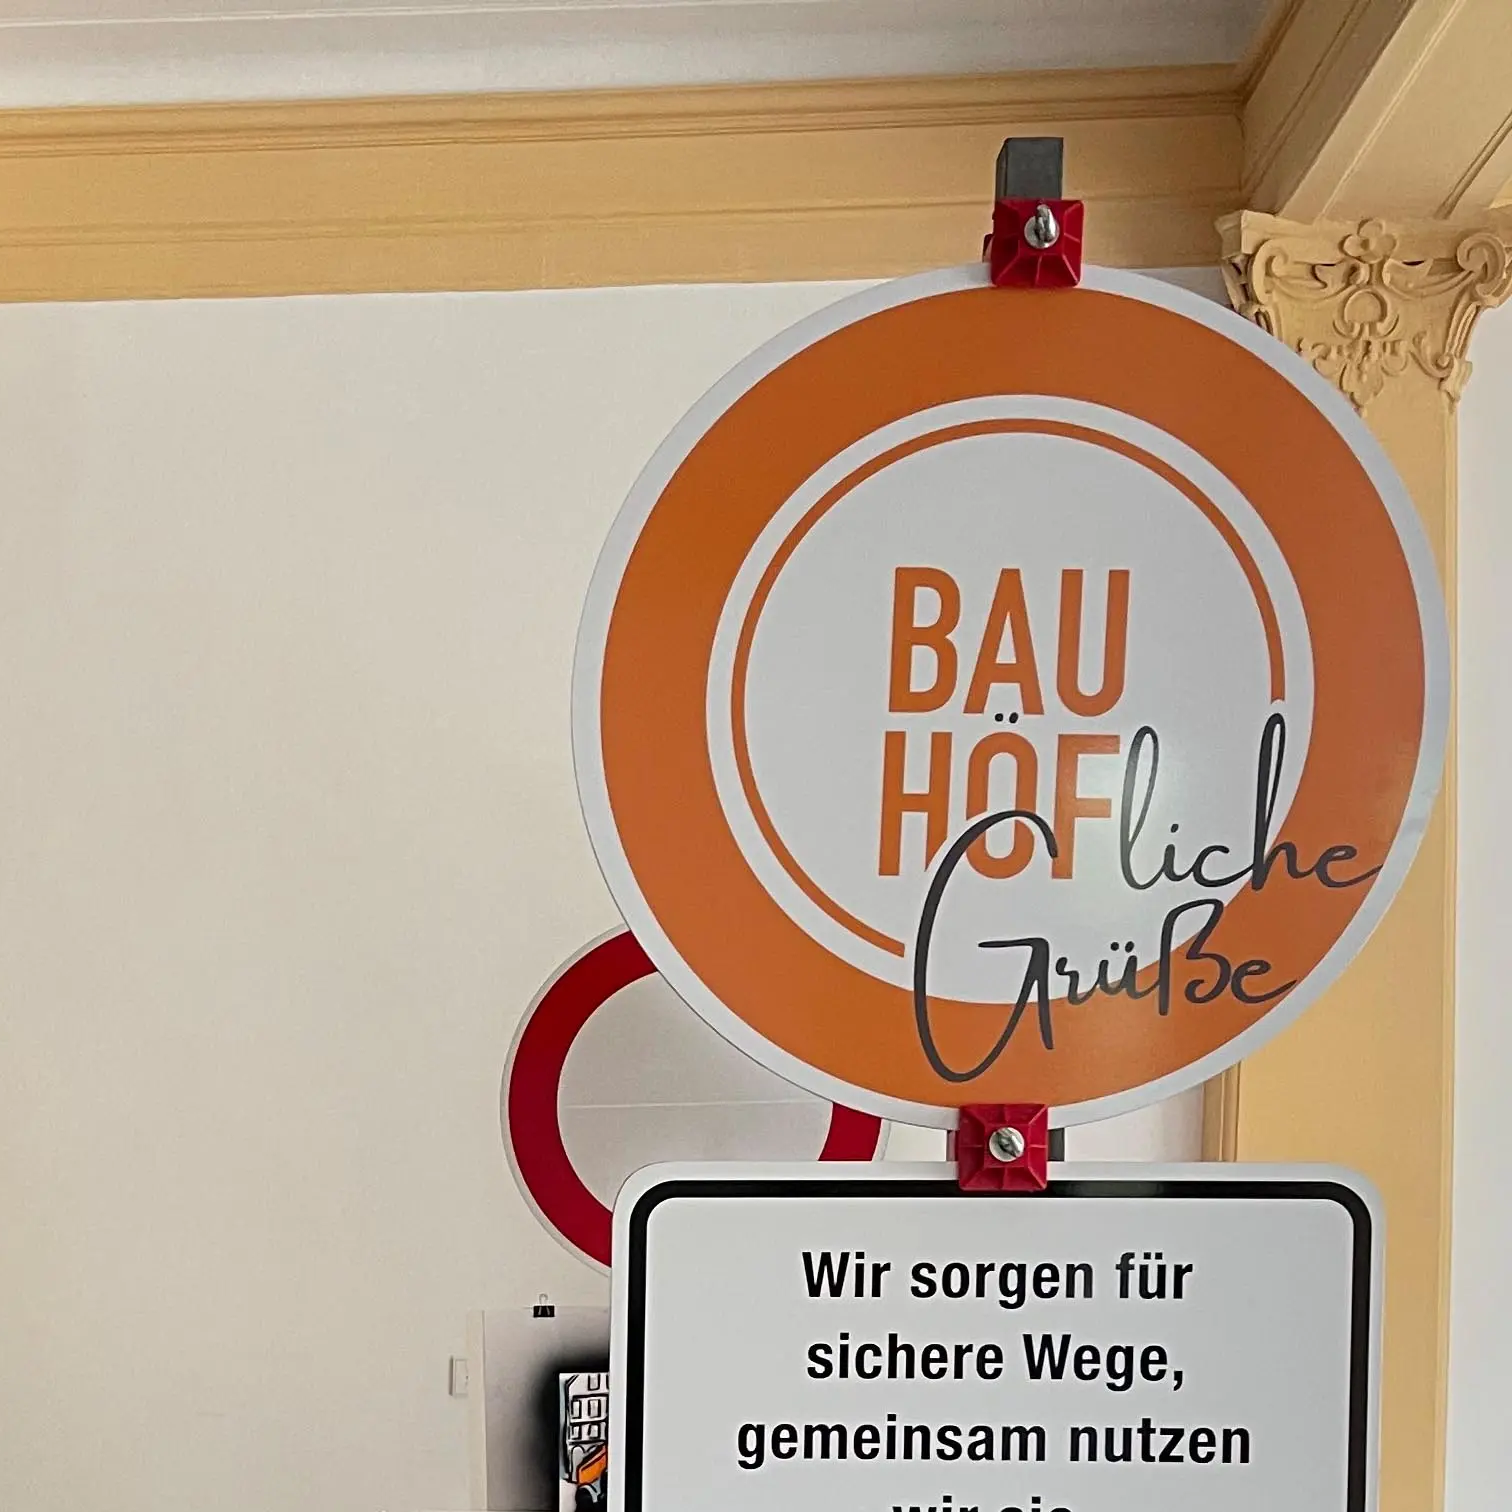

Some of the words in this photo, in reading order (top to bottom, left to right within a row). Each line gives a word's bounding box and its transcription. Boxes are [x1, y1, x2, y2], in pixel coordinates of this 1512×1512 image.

[888, 567, 1130, 717] BAU
[914, 809, 1298, 1082] Grüße
[802, 1251, 891, 1299] Wir
[910, 1260, 1094, 1309] sorgen
[1114, 1251, 1194, 1300] für
[806, 1332, 1005, 1380] sichere
[1022, 1333, 1185, 1392] Wege,
[737, 1413, 1047, 1470] gemeinsam
[1069, 1417, 1251, 1464] nutzen
